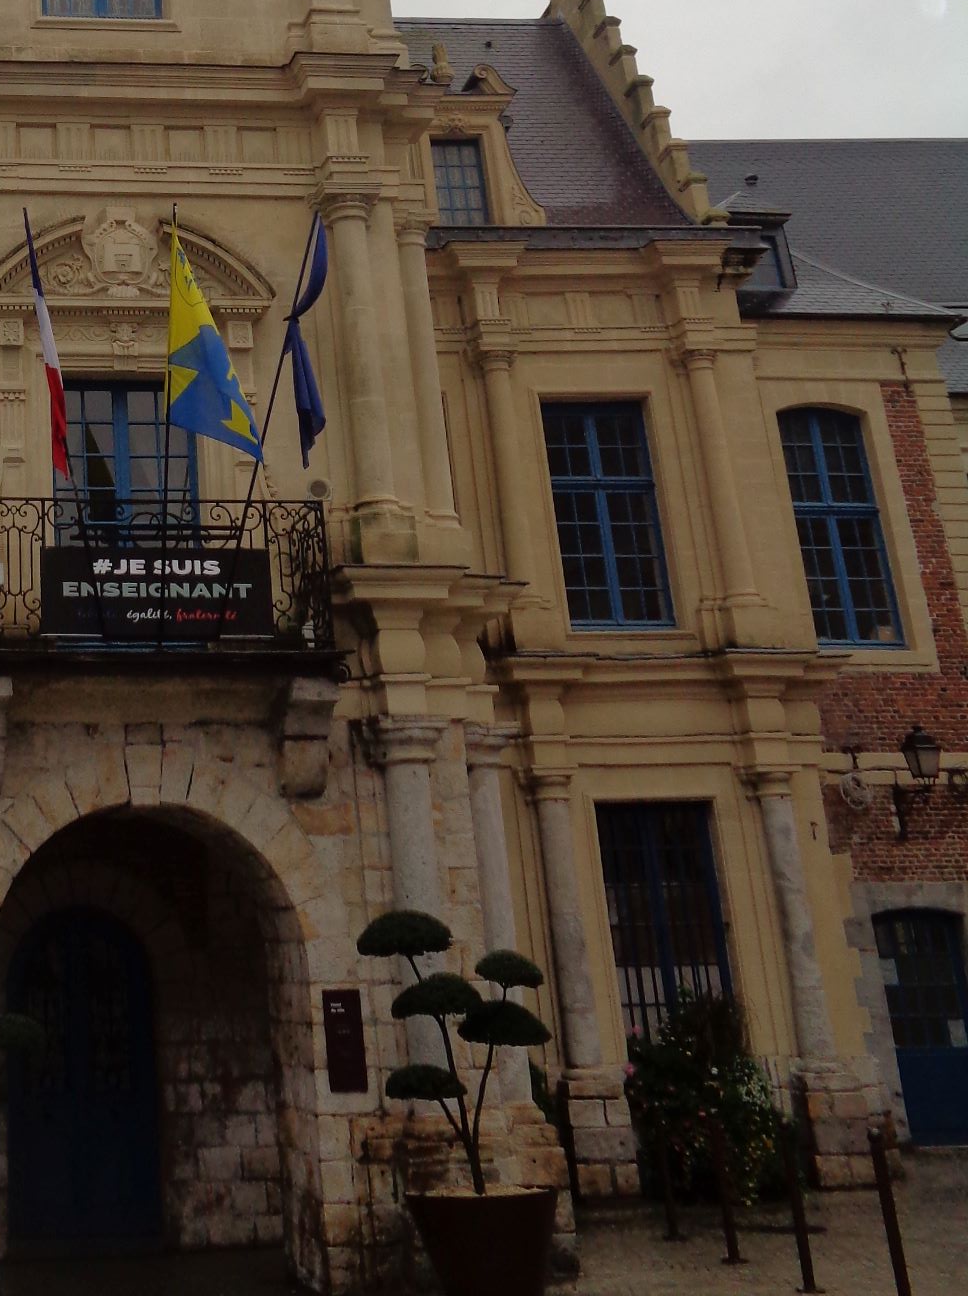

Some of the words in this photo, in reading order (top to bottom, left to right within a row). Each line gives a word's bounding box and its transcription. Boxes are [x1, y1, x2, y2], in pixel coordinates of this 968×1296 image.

[92, 558, 146, 575] #JE
[153, 559, 221, 576] SUIS
[62, 581, 253, 599] ENSEIGNANT
[175, 608, 238, 621] fraternté
